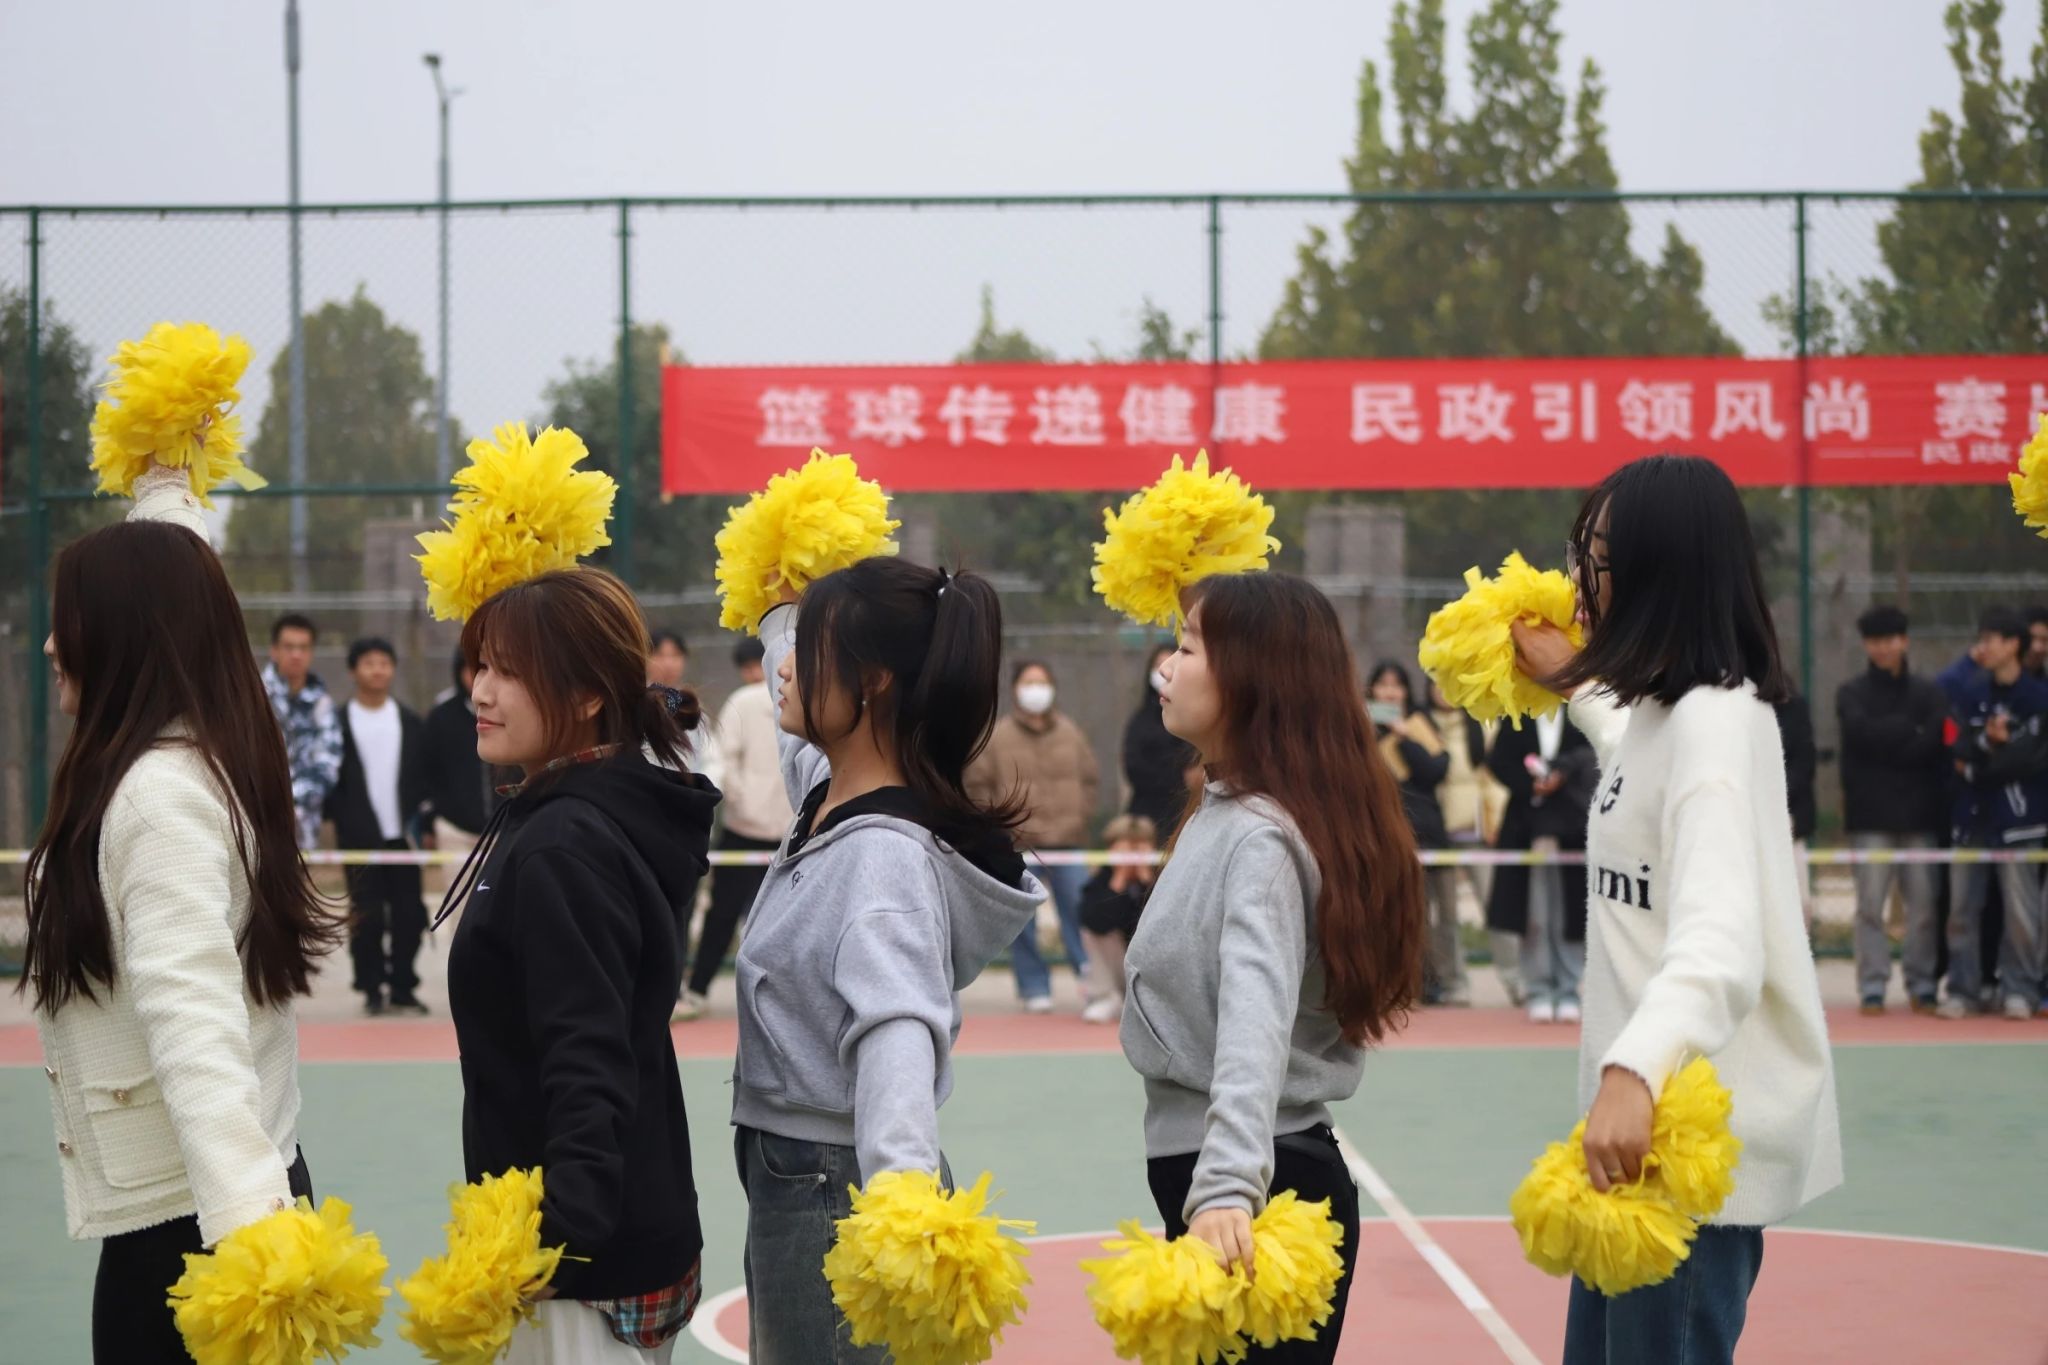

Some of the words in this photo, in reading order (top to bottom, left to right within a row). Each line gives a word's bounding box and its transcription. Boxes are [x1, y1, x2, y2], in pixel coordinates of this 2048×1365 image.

[757, 383, 1288, 447] 篮球传递健康
[1350, 378, 1871, 444] 民政引领风尚
[1593, 864, 1652, 911] mi
